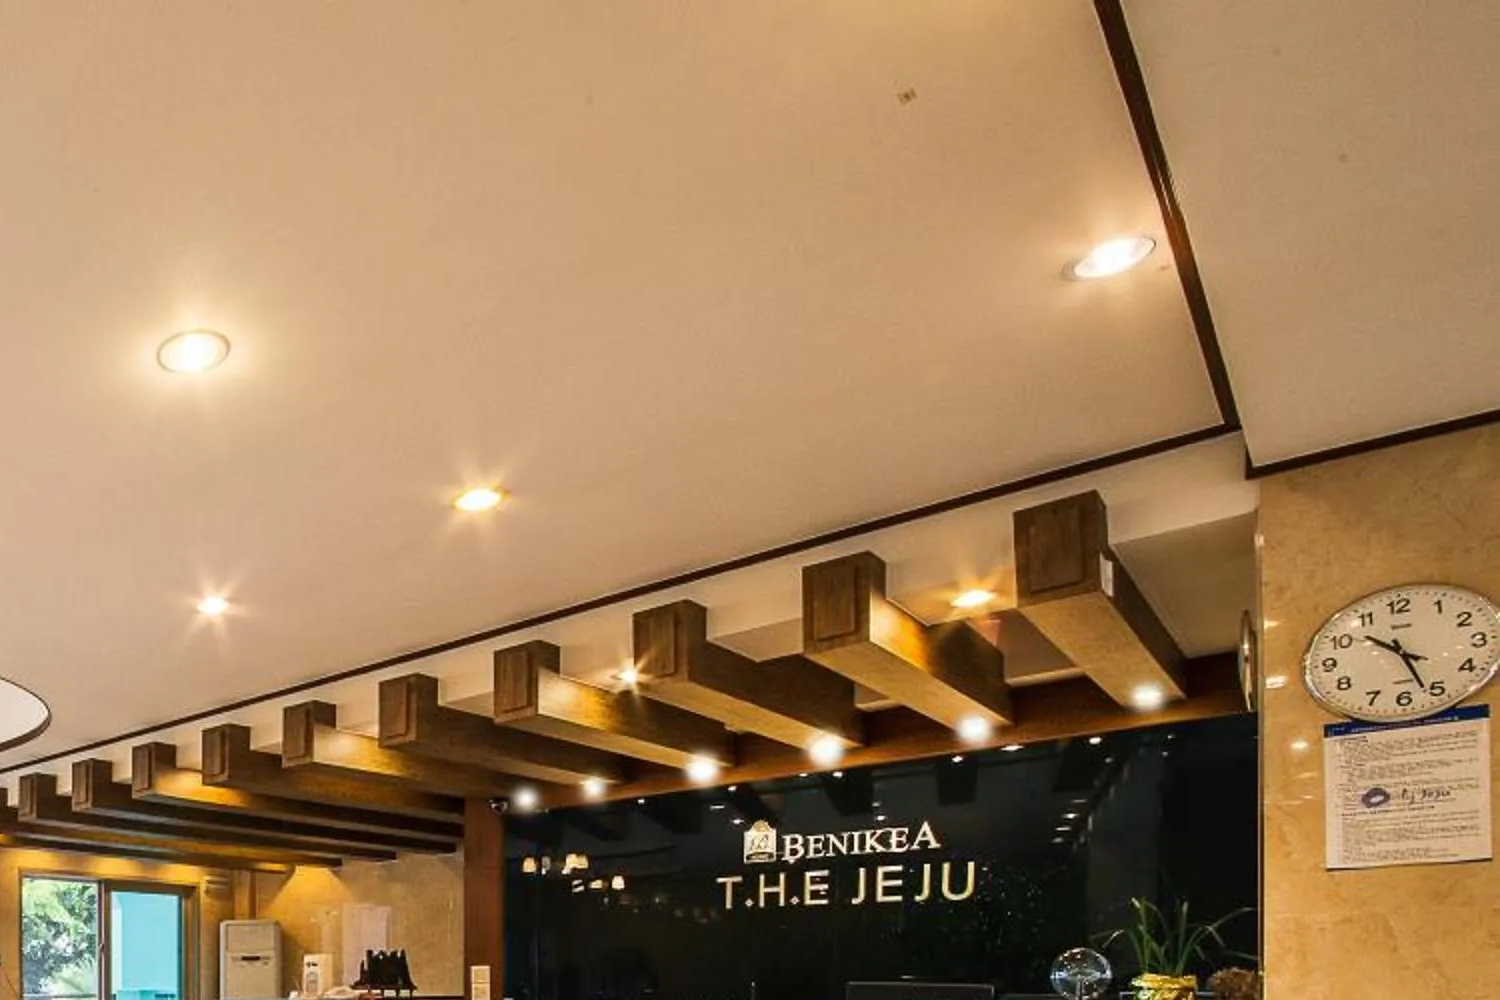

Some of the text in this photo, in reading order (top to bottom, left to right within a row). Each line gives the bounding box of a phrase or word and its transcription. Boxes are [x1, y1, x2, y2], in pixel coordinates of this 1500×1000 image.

[1387, 599, 1410, 614] 12
[1433, 600, 1443, 614] 1
[1358, 612, 1374, 627] 11
[1457, 612, 1472, 627] 2
[1331, 633, 1352, 650] 10
[1471, 632, 1487, 647] 3
[1322, 657, 1337, 672] 9
[1458, 657, 1475, 673] 4
[1336, 676, 1351, 691] 8
[1429, 681, 1445, 696] 5
[1366, 690, 1381, 706] 7
[1396, 692, 1412, 706] 6
[781, 821, 941, 861] BENIKEA
[716, 862, 975, 909] T.H.E JEJU
